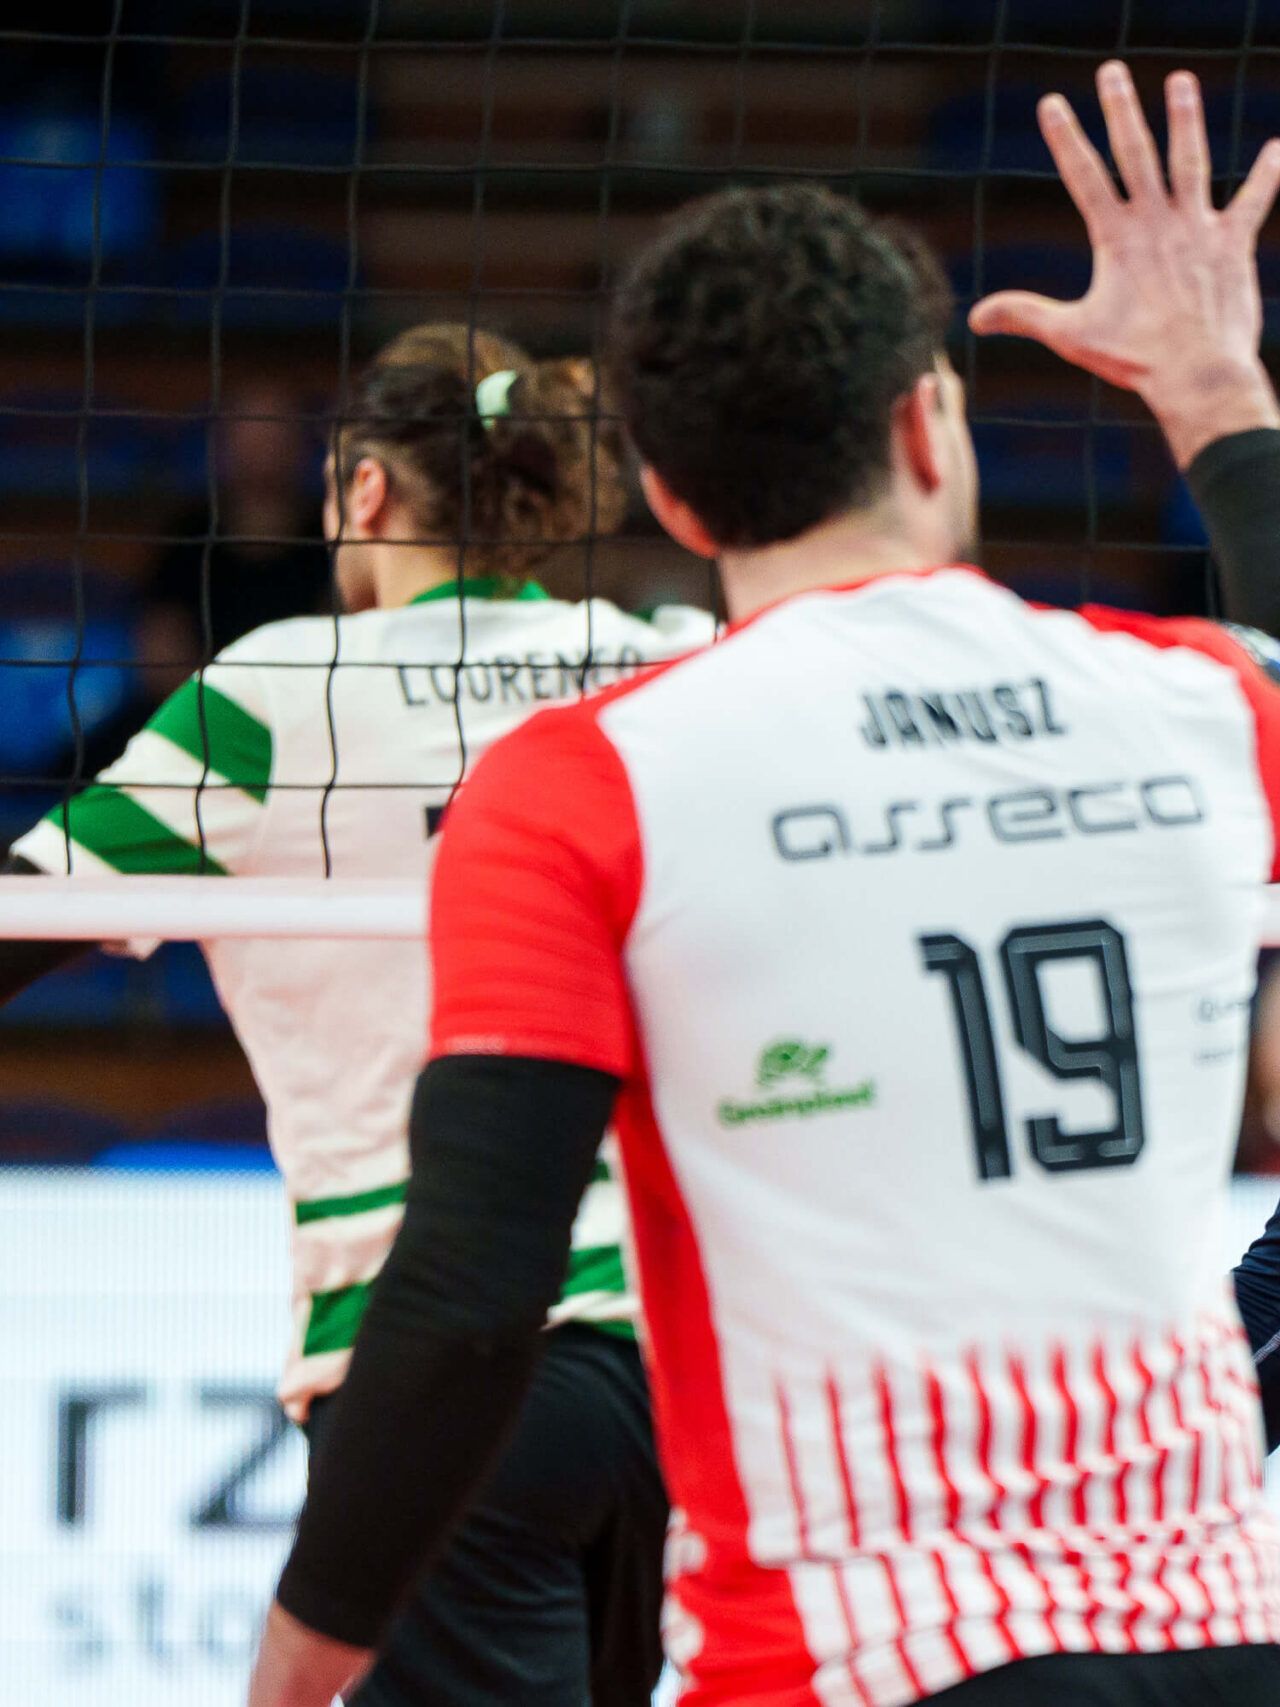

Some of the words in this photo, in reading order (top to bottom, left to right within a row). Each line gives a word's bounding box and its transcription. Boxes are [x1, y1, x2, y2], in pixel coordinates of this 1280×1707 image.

[859, 676, 1067, 749] JANUSZ
[770, 775, 1204, 862] asseco
[915, 918, 1146, 1186] 19
